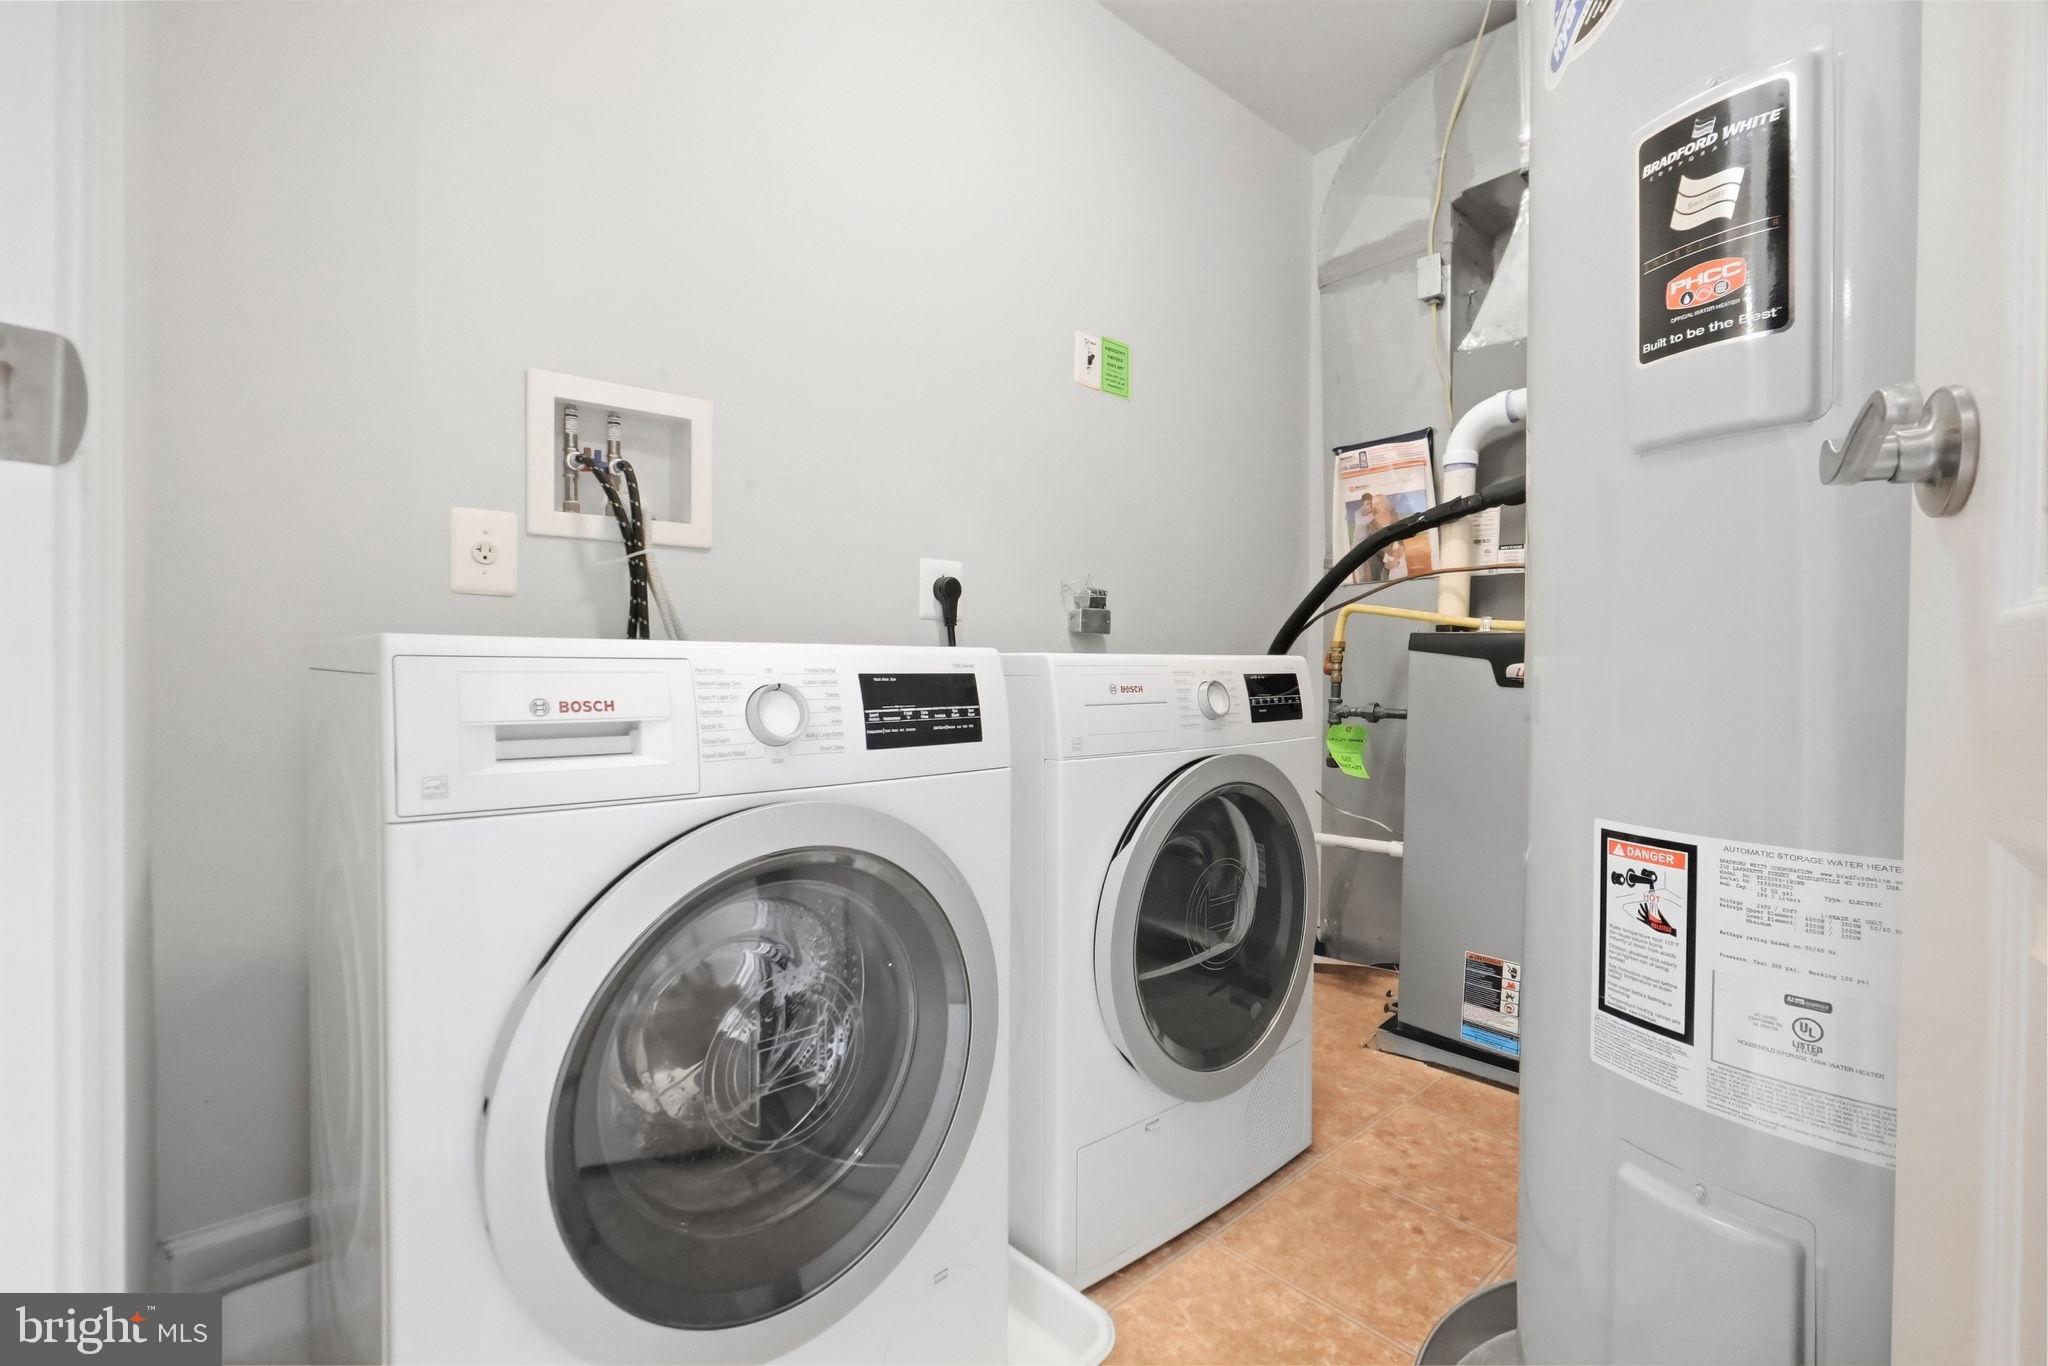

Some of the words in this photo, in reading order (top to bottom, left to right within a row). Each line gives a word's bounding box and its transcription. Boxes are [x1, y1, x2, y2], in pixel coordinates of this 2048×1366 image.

[1642, 132, 1718, 180] BRADFORD
[1722, 107, 1782, 140] WHITE
[1670, 261, 1742, 295] PHCC
[1642, 336, 1667, 354] Built
[1669, 332, 1684, 344] to
[1686, 326, 1705, 338] be
[1708, 318, 1734, 333] the
[1120, 685, 1144, 693] BOSCH
[559, 700, 615, 713] BOSCH
[1627, 847, 1674, 864] DANGER
[1723, 845, 1775, 859] AUTOMATIC
[1777, 852, 1824, 865] STORAGE
[1827, 859, 1863, 869] WATER
[1867, 864, 1904, 873] HEATE
[1799, 1021, 1816, 1038] UL
